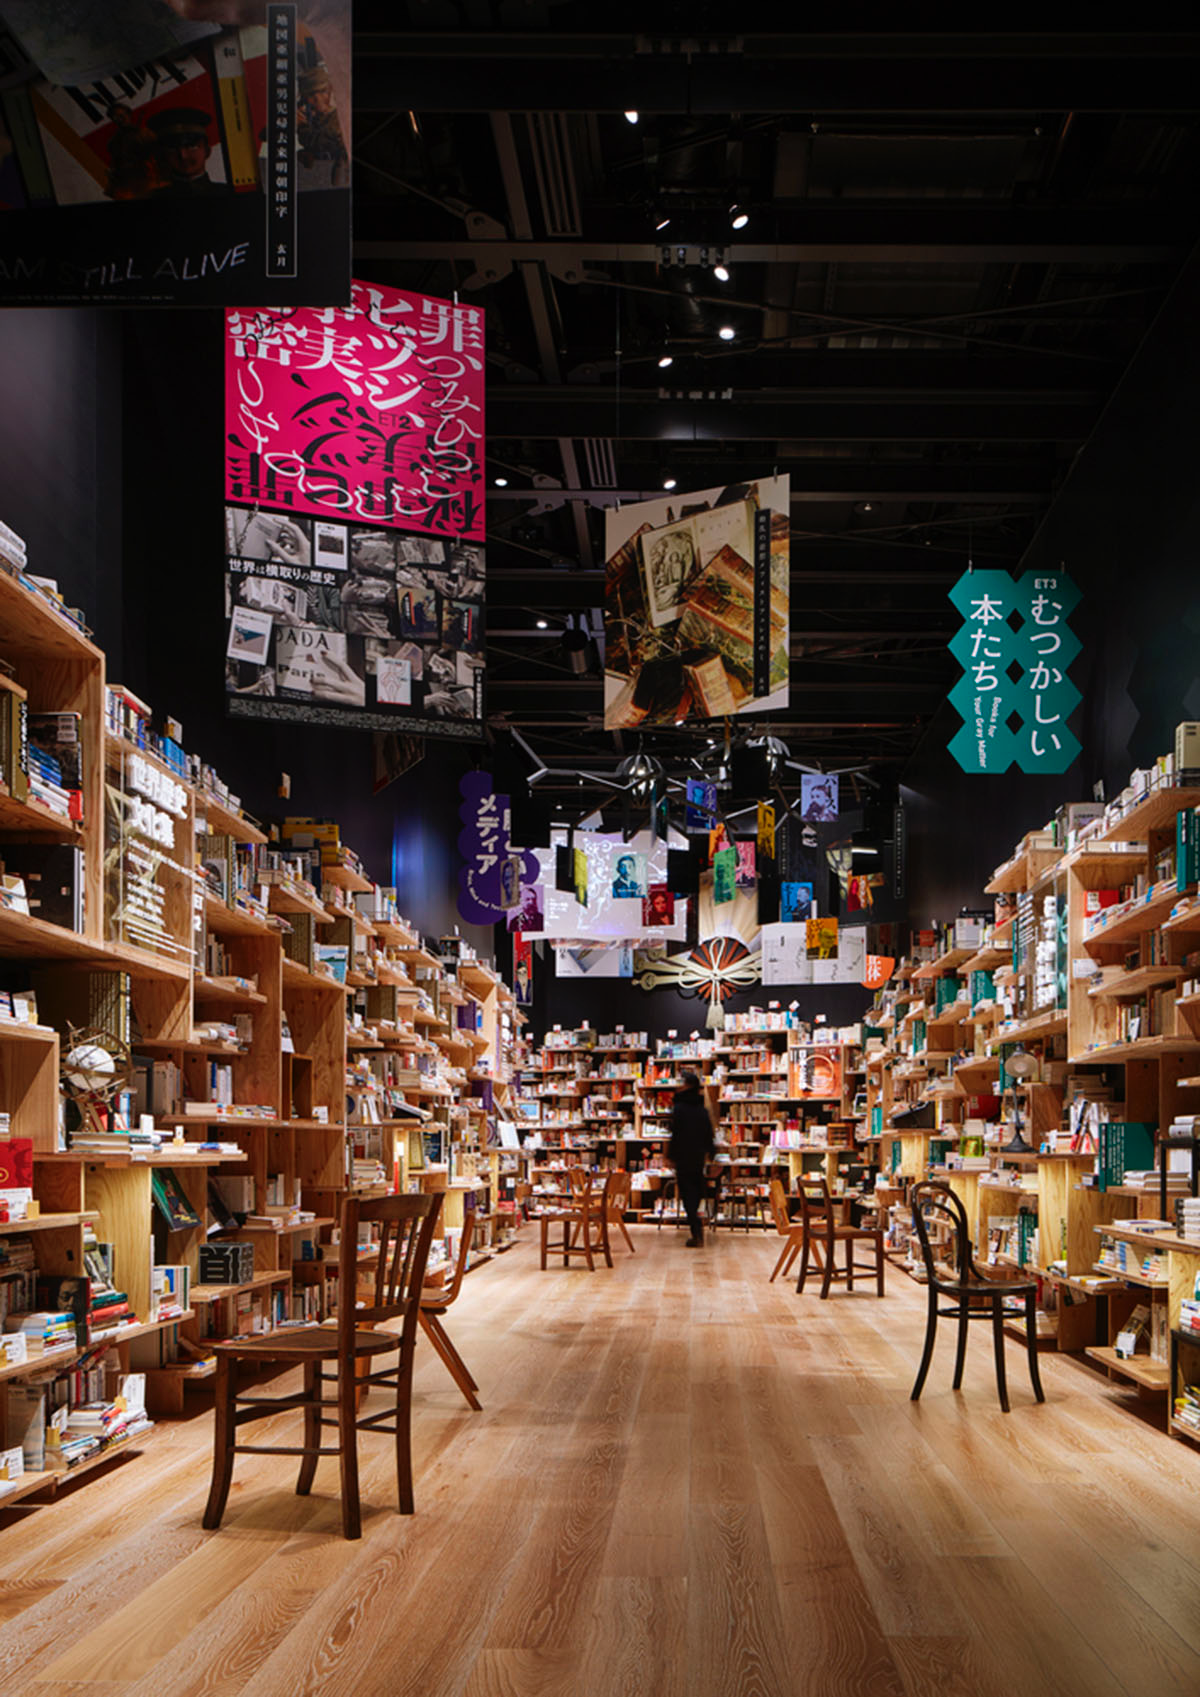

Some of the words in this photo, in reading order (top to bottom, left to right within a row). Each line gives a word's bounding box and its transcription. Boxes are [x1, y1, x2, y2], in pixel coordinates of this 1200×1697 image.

[153, 242, 250, 281] ALIVE
[378, 413, 411, 430] ET2
[1034, 578, 1057, 590] ET3
[970, 593, 1003, 692] 本たち
[1029, 594, 1063, 756] むつかしい
[990, 697, 1002, 723] Books
[475, 793, 500, 875] メディア
